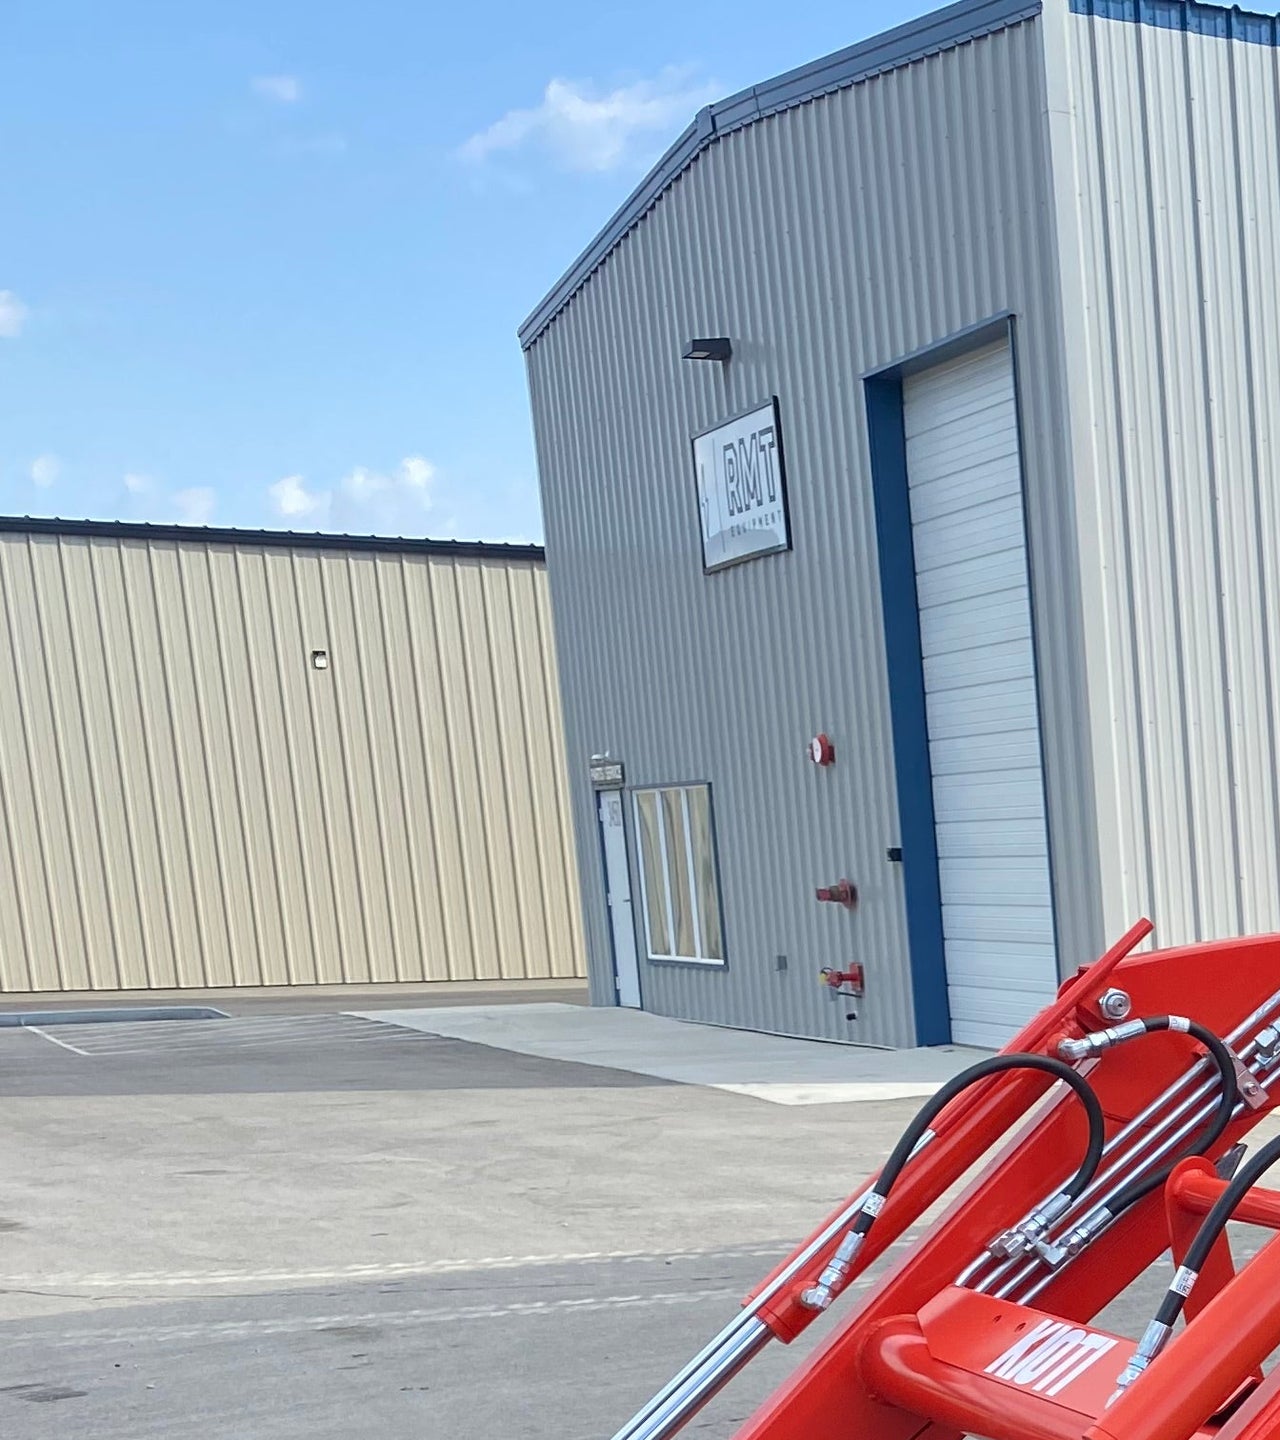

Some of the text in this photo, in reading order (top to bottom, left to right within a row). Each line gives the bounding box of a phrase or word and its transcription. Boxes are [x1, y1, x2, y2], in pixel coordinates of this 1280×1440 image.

[723, 425, 776, 516] RMT
[730, 510, 782, 537] EQUIPMENT
[983, 1318, 1119, 1396] KIOTI
